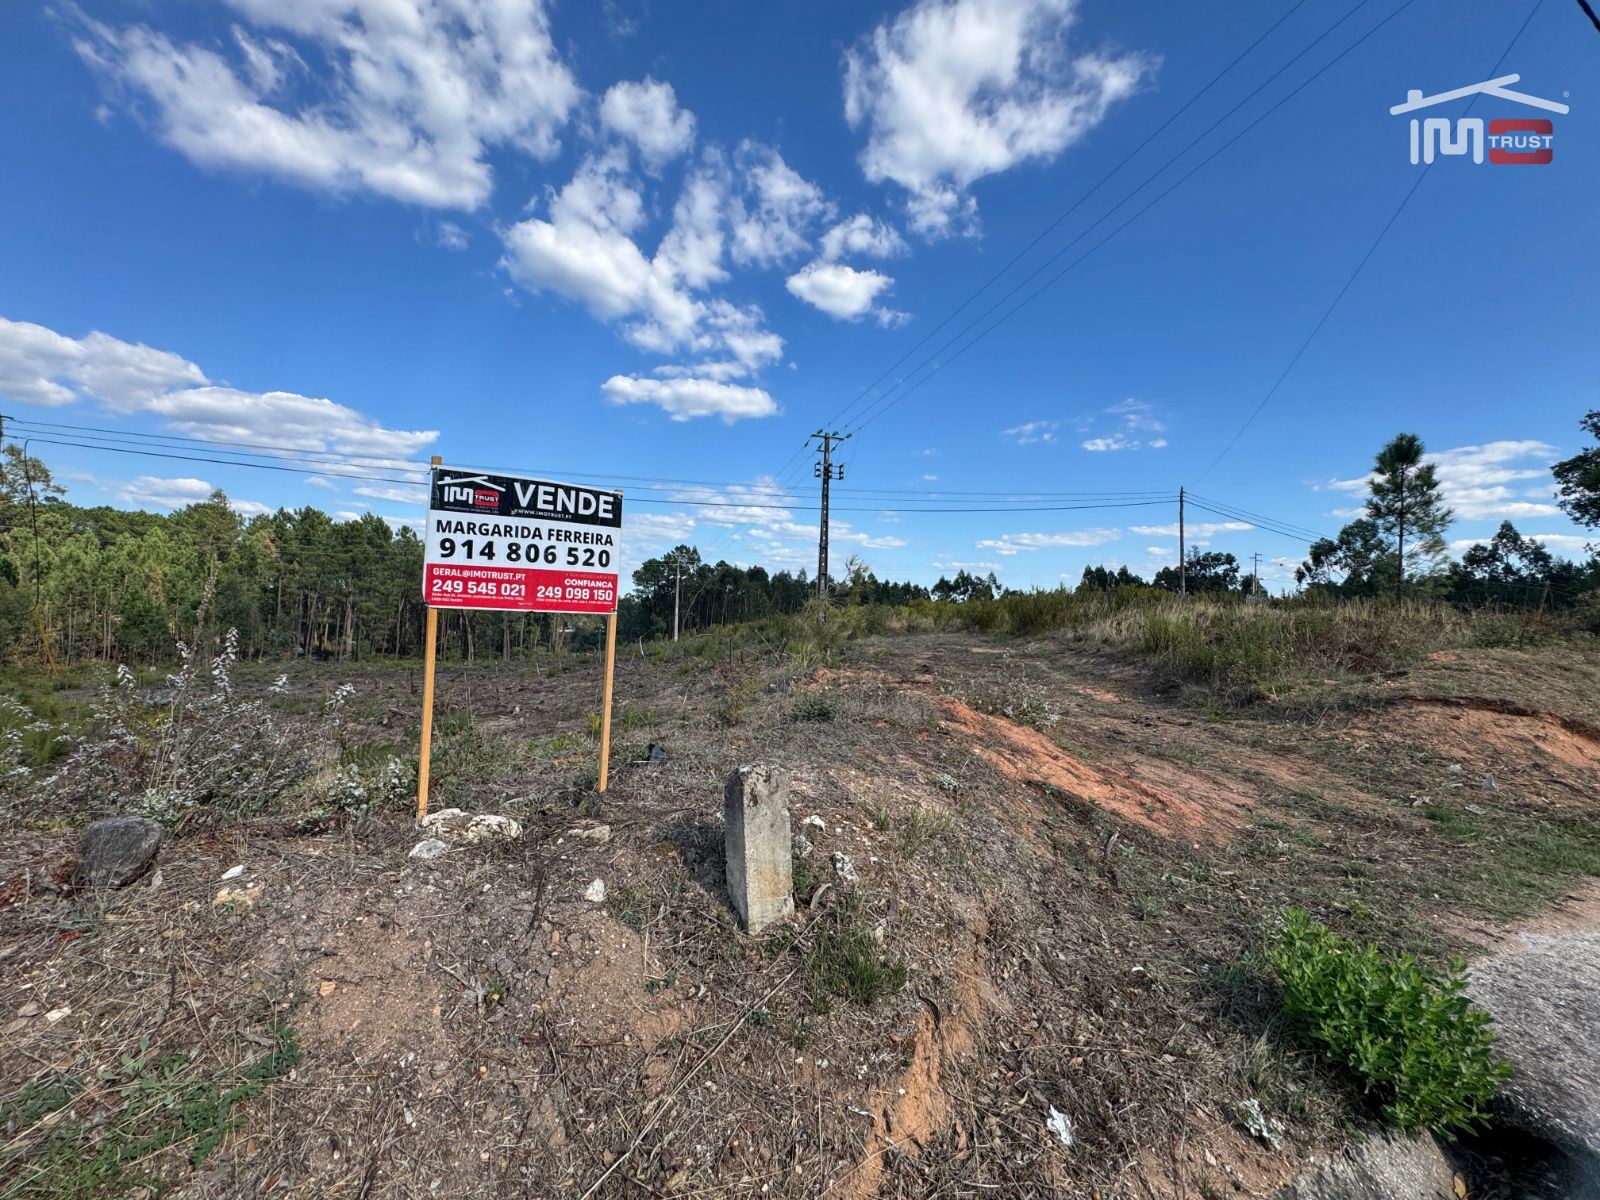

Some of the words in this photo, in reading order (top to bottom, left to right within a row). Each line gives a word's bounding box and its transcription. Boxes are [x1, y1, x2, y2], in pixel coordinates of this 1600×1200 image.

[475, 494, 499, 502] TRUST
[514, 482, 614, 519] VENDE
[436, 519, 543, 541] MARGARIDA
[547, 528, 614, 546] FERREIRA
[439, 537, 496, 561] 914
[506, 542, 557, 564] 806
[566, 546, 611, 568] 520
[433, 567, 526, 581] GERAL@IMOTRUST.PT
[432, 579, 463, 593] 249
[467, 581, 497, 595] 545
[501, 583, 525, 596] 021
[536, 585, 562, 598] 249
[565, 587, 590, 600] 098
[593, 589, 613, 601] 150
